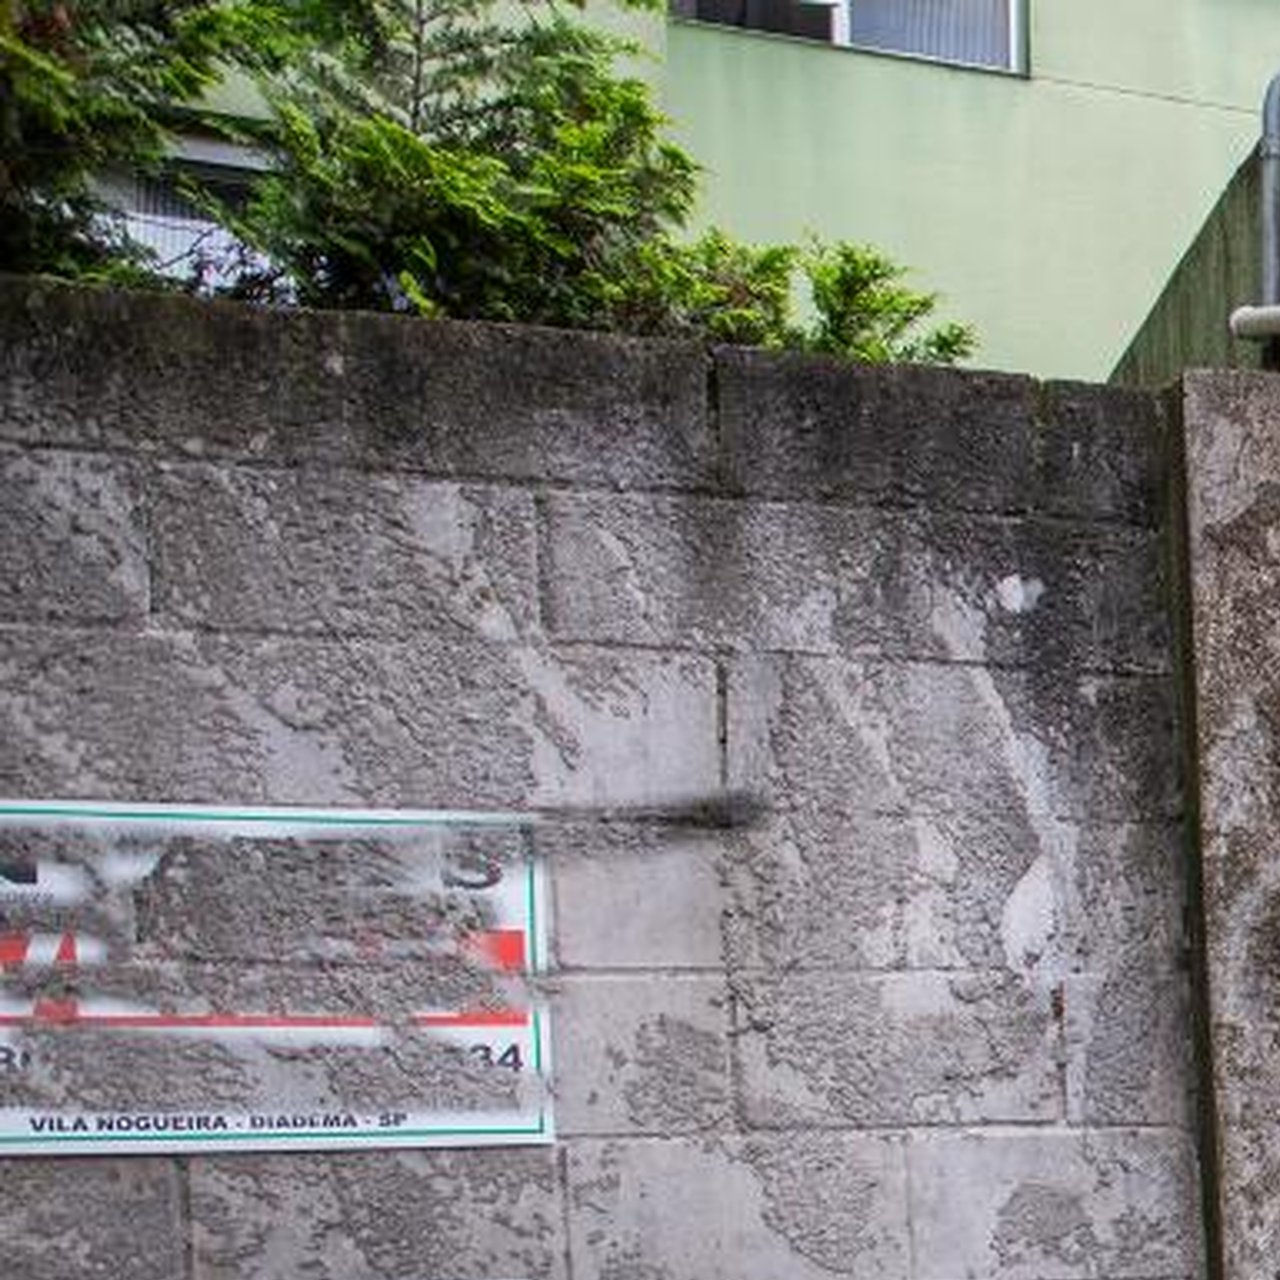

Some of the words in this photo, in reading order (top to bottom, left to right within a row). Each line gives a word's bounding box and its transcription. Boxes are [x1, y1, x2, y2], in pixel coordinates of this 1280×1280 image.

[29, 1116, 89, 1132] VILA
[99, 1115, 229, 1132] NOGUEIRA
[250, 1114, 358, 1129] DIADEMA
[378, 1112, 408, 1128] SP
